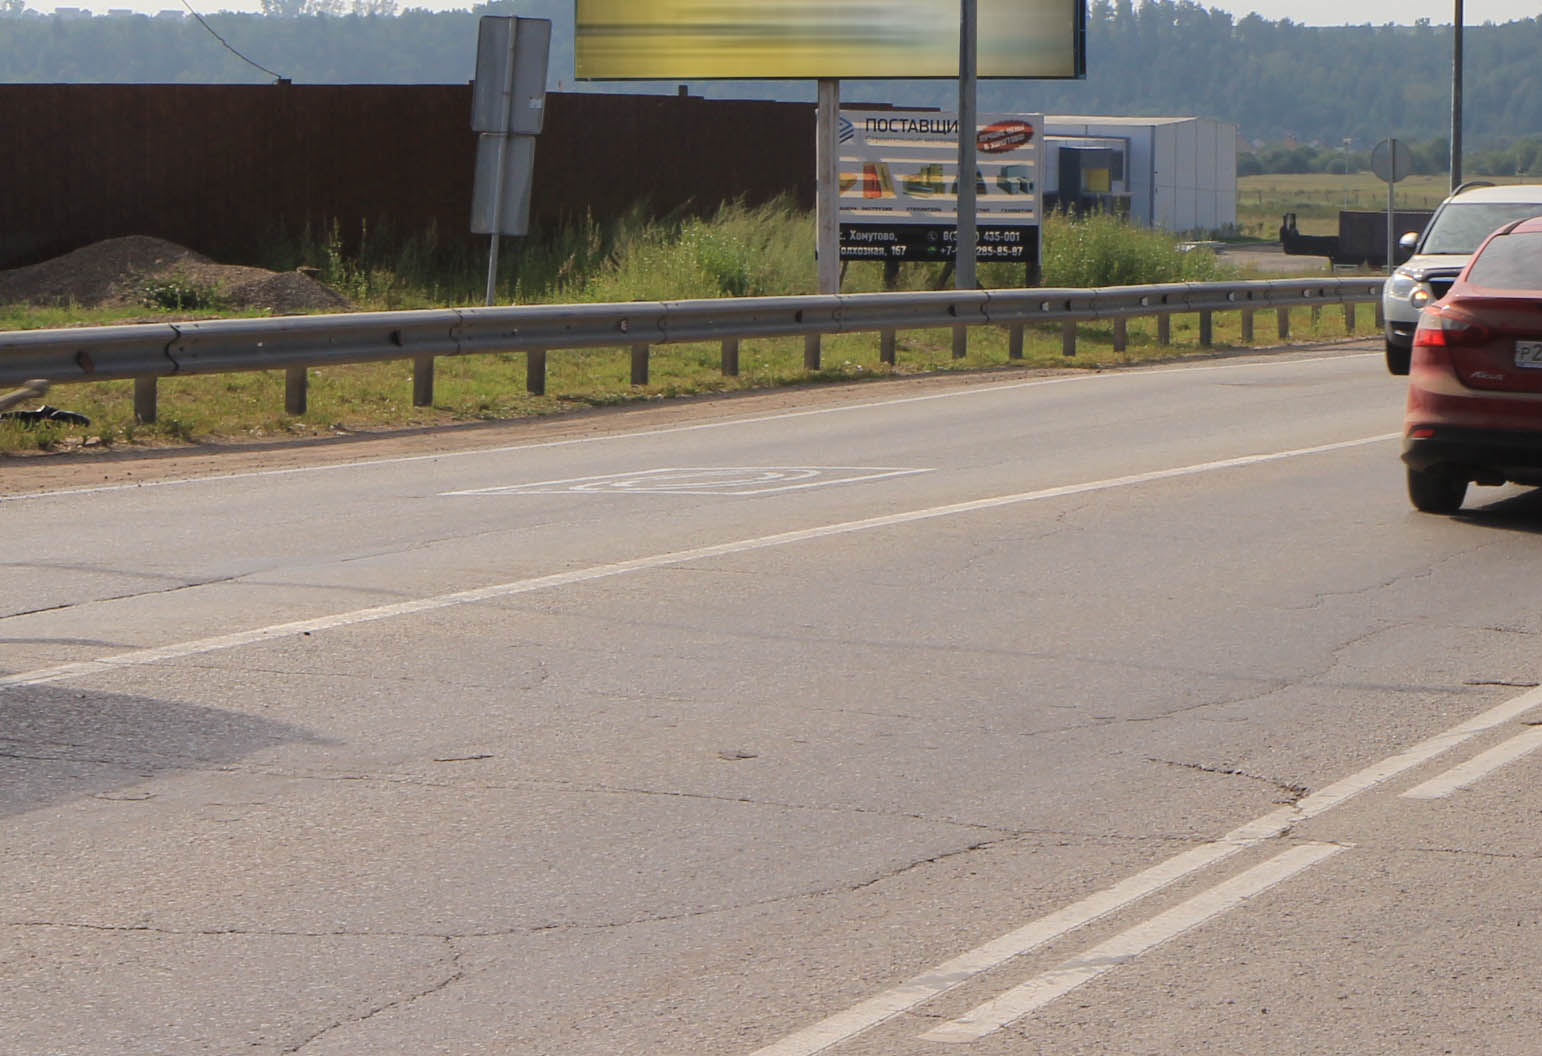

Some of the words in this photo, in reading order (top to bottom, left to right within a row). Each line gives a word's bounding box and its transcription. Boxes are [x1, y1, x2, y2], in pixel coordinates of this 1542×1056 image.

[865, 118, 958, 135] ПОСТАВЩИ
[849, 230, 898, 242] Хомутово,
[984, 231, 1020, 241] 435-001
[840, 246, 888, 256] олхозная,
